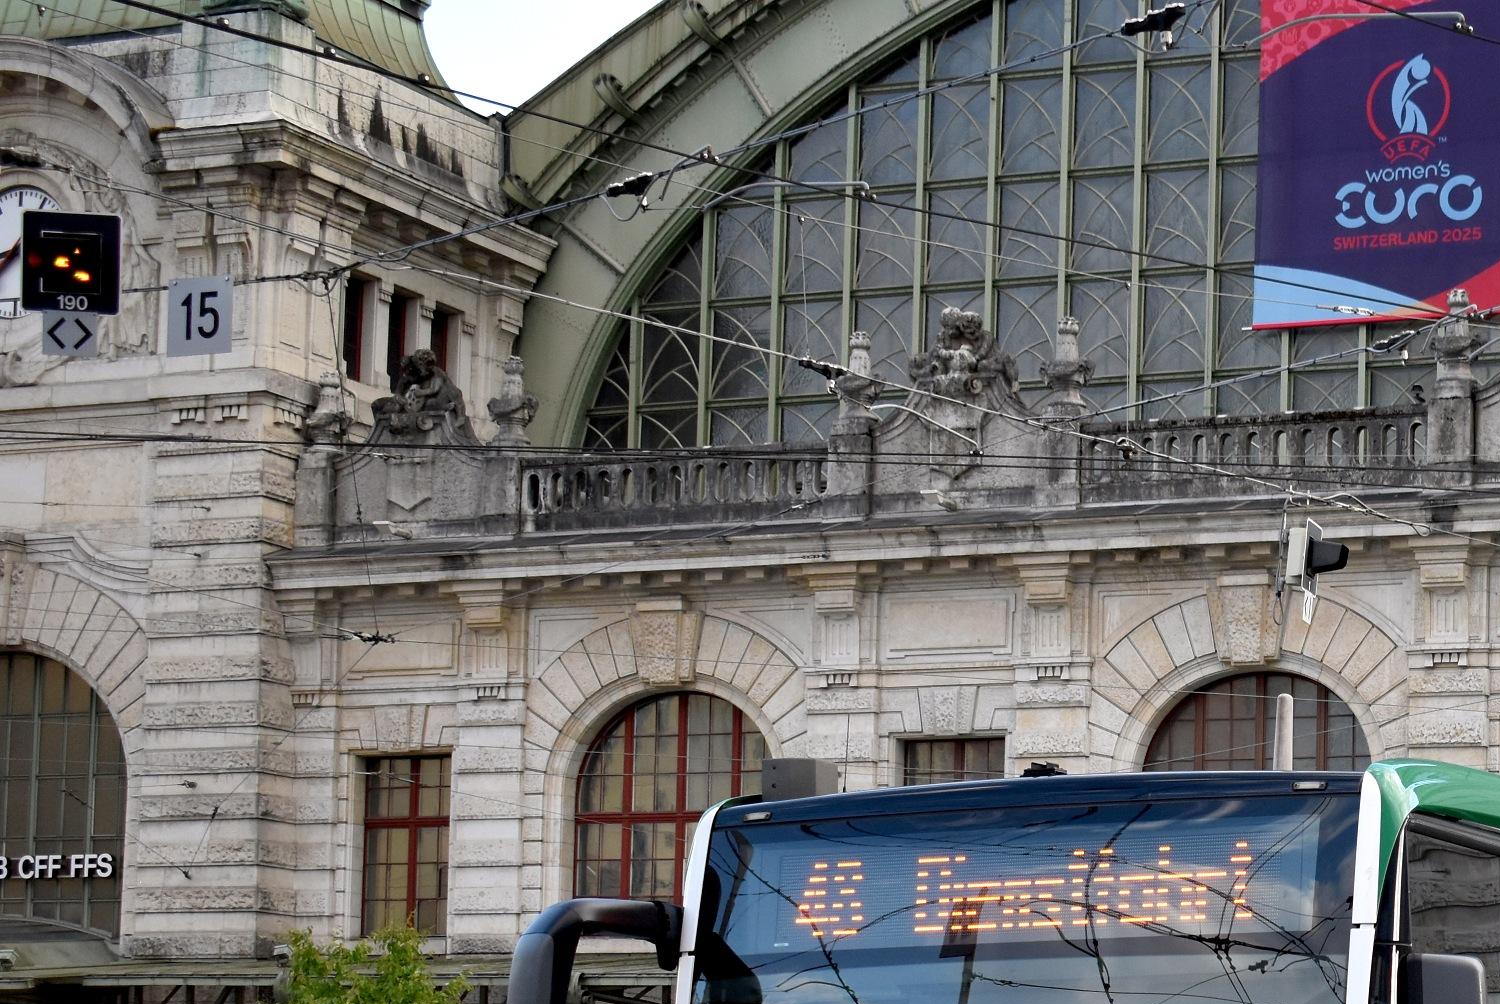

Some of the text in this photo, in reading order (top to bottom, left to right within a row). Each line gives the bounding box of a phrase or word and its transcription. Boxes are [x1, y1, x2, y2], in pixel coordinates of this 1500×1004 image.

[1383, 139, 1430, 160] UEFA
[1365, 160, 1451, 183] women's
[1333, 227, 1483, 251] SWITZERLAND 2025
[57, 294, 88, 311] 190
[180, 290, 221, 342] 15
[18, 854, 62, 880] CFF
[70, 853, 113, 878] FFS
